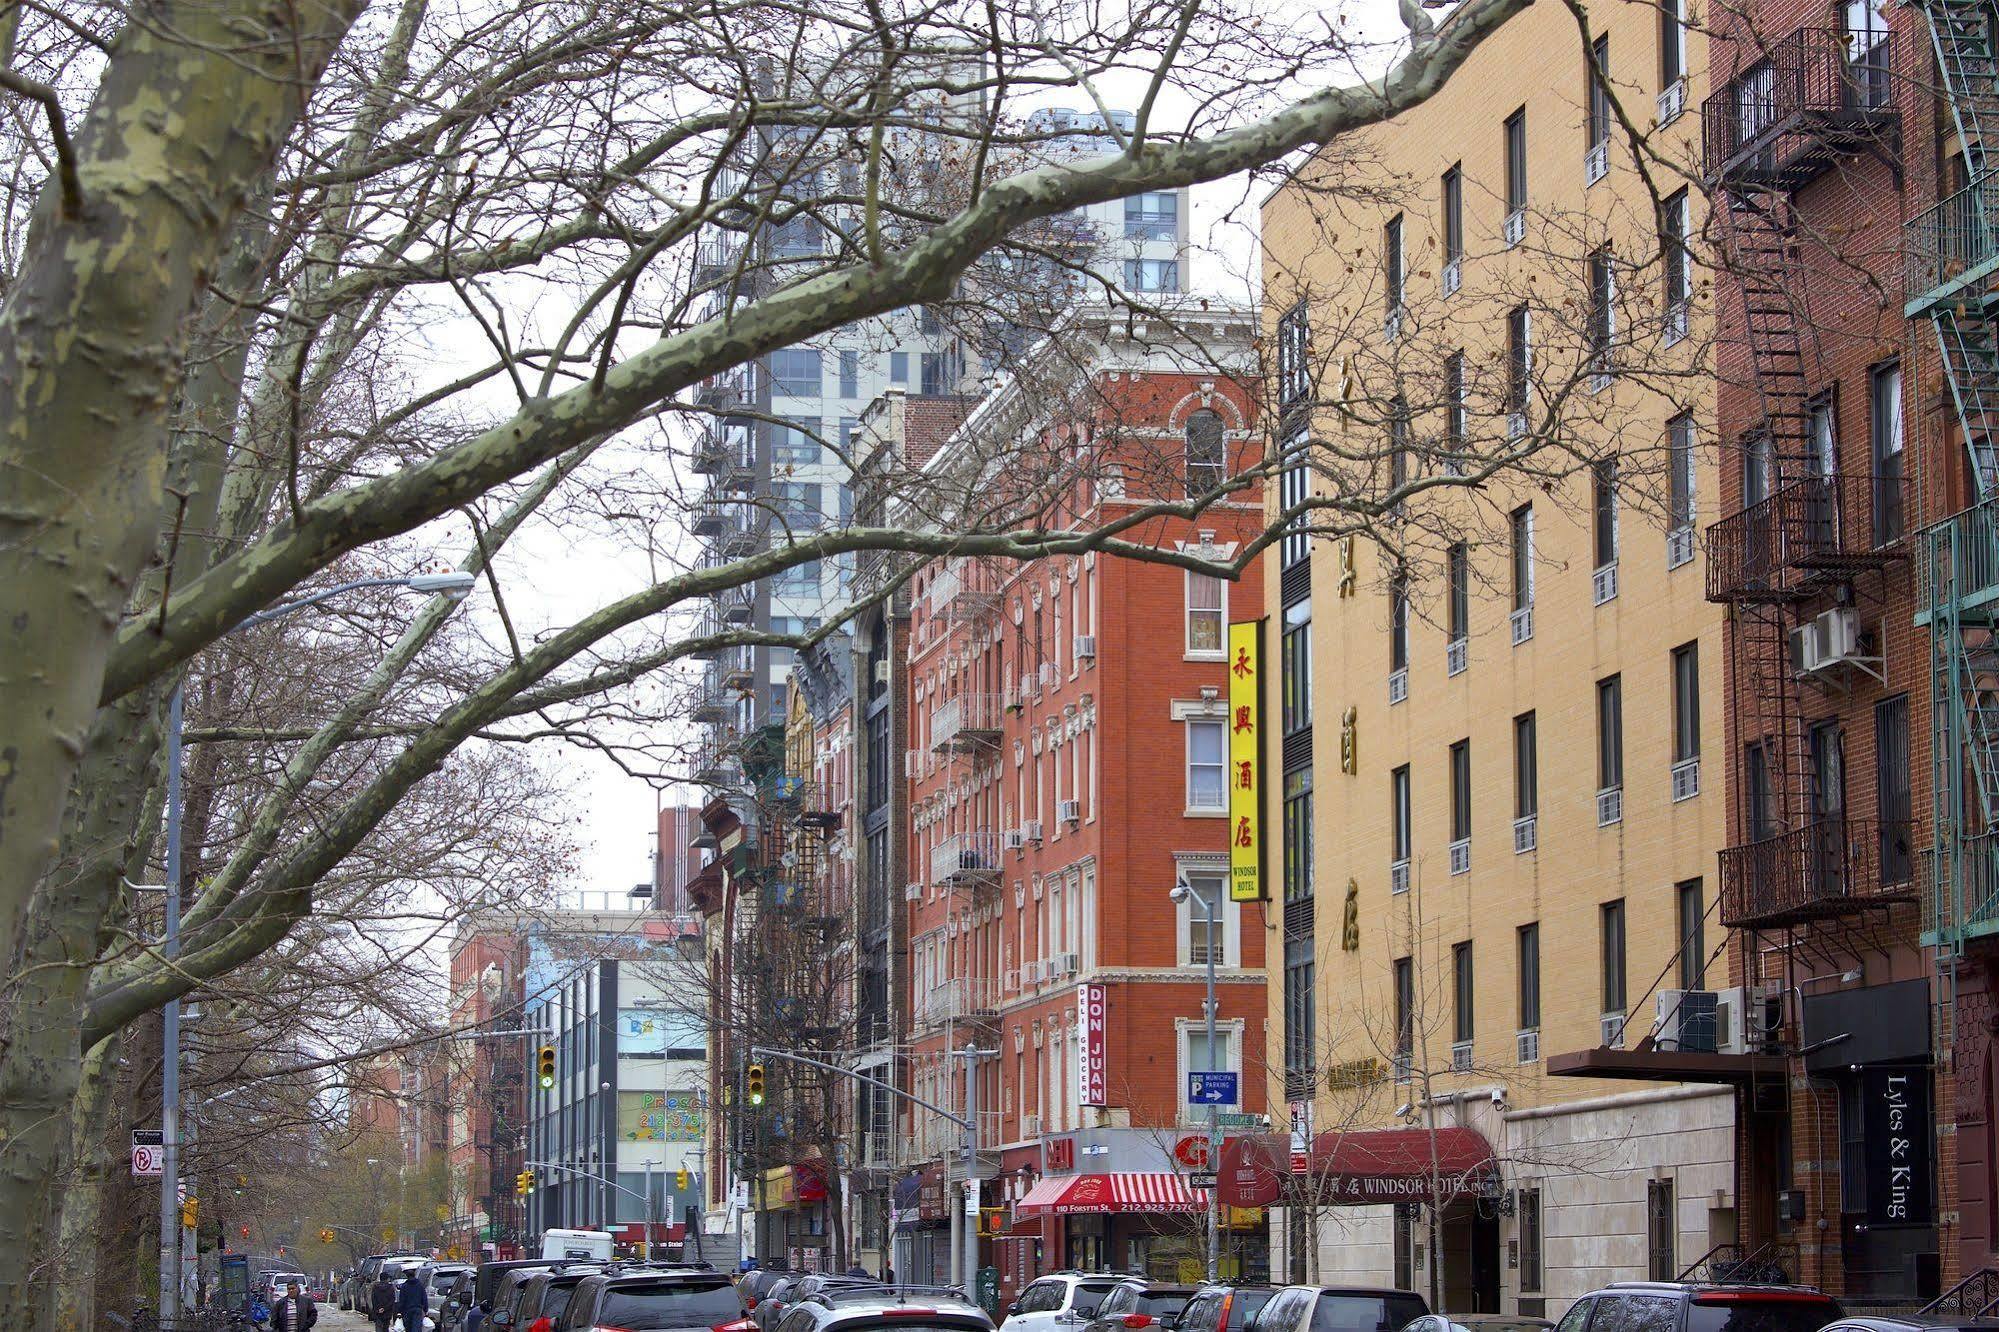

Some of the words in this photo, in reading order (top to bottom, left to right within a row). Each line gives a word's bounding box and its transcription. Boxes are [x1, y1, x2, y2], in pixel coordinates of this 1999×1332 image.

[1233, 647, 1254, 848] 永興酒店
[1233, 867, 1256, 876] WINDSOR
[1237, 881, 1254, 891] HOTEL
[1090, 989, 1102, 1031] DON
[1091, 1043, 1102, 1101] JUAN
[1884, 1075, 1907, 1131] Lyles
[1891, 1137, 1910, 1159] &
[1364, 1179, 1423, 1194] WINDSOR
[1887, 1165, 1911, 1218] King
